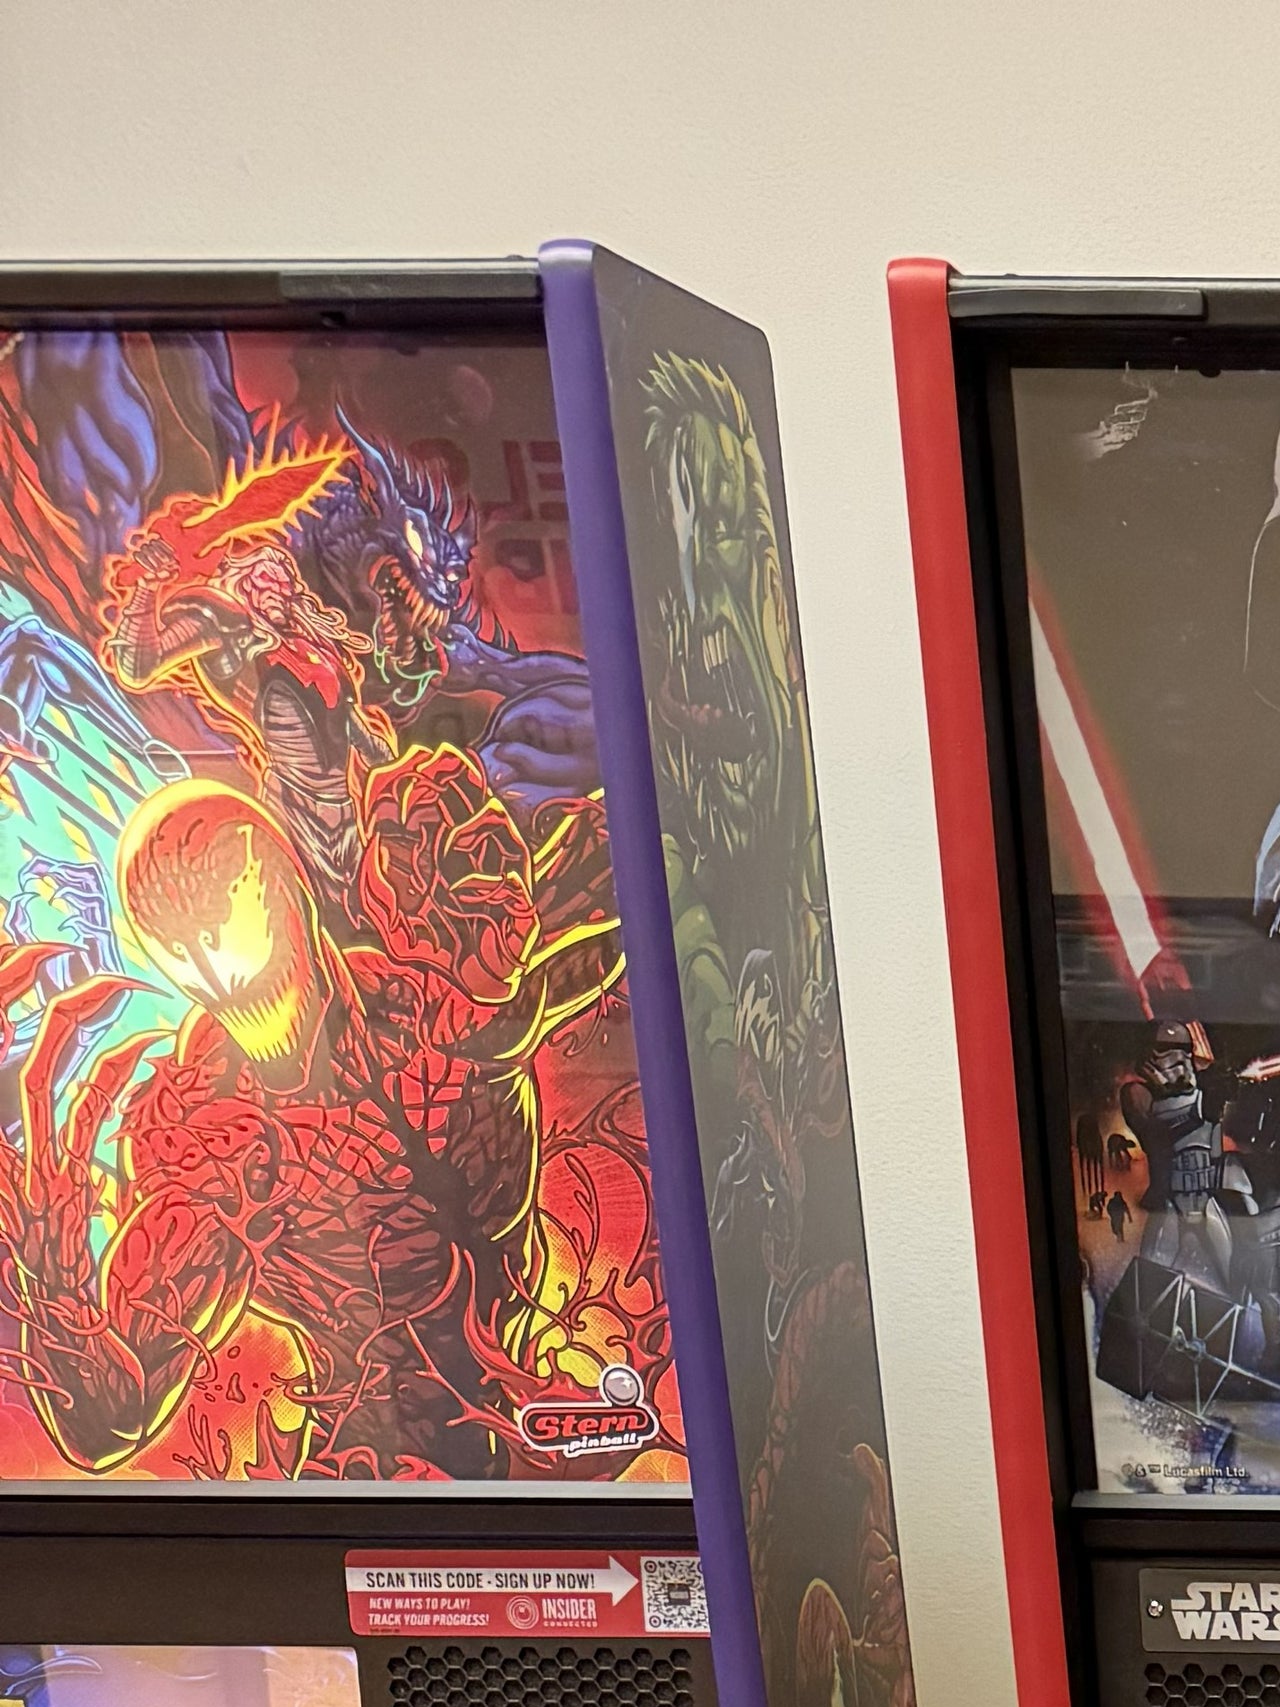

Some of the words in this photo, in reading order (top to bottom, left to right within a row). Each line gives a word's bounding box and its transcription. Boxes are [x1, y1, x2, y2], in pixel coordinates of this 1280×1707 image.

[535, 1414, 639, 1440] Stern
[569, 1433, 637, 1451] pinball
[1164, 1464, 1222, 1477] Lucasfilm
[366, 1572, 406, 1588] SCAN
[410, 1572, 442, 1589] THIS
[446, 1572, 484, 1589] CODE
[495, 1573, 529, 1589] SIGN
[533, 1573, 552, 1589] UP
[556, 1573, 595, 1590] NOW!
[369, 1597, 392, 1610] NEW
[394, 1597, 423, 1610] WAYS
[425, 1597, 437, 1610] TO
[438, 1597, 470, 1610] PLAY!
[542, 1598, 597, 1620] INSIDER
[368, 1613, 402, 1626] TRACK
[405, 1613, 431, 1626] YOUR
[433, 1613, 489, 1626] PROGRESS!
